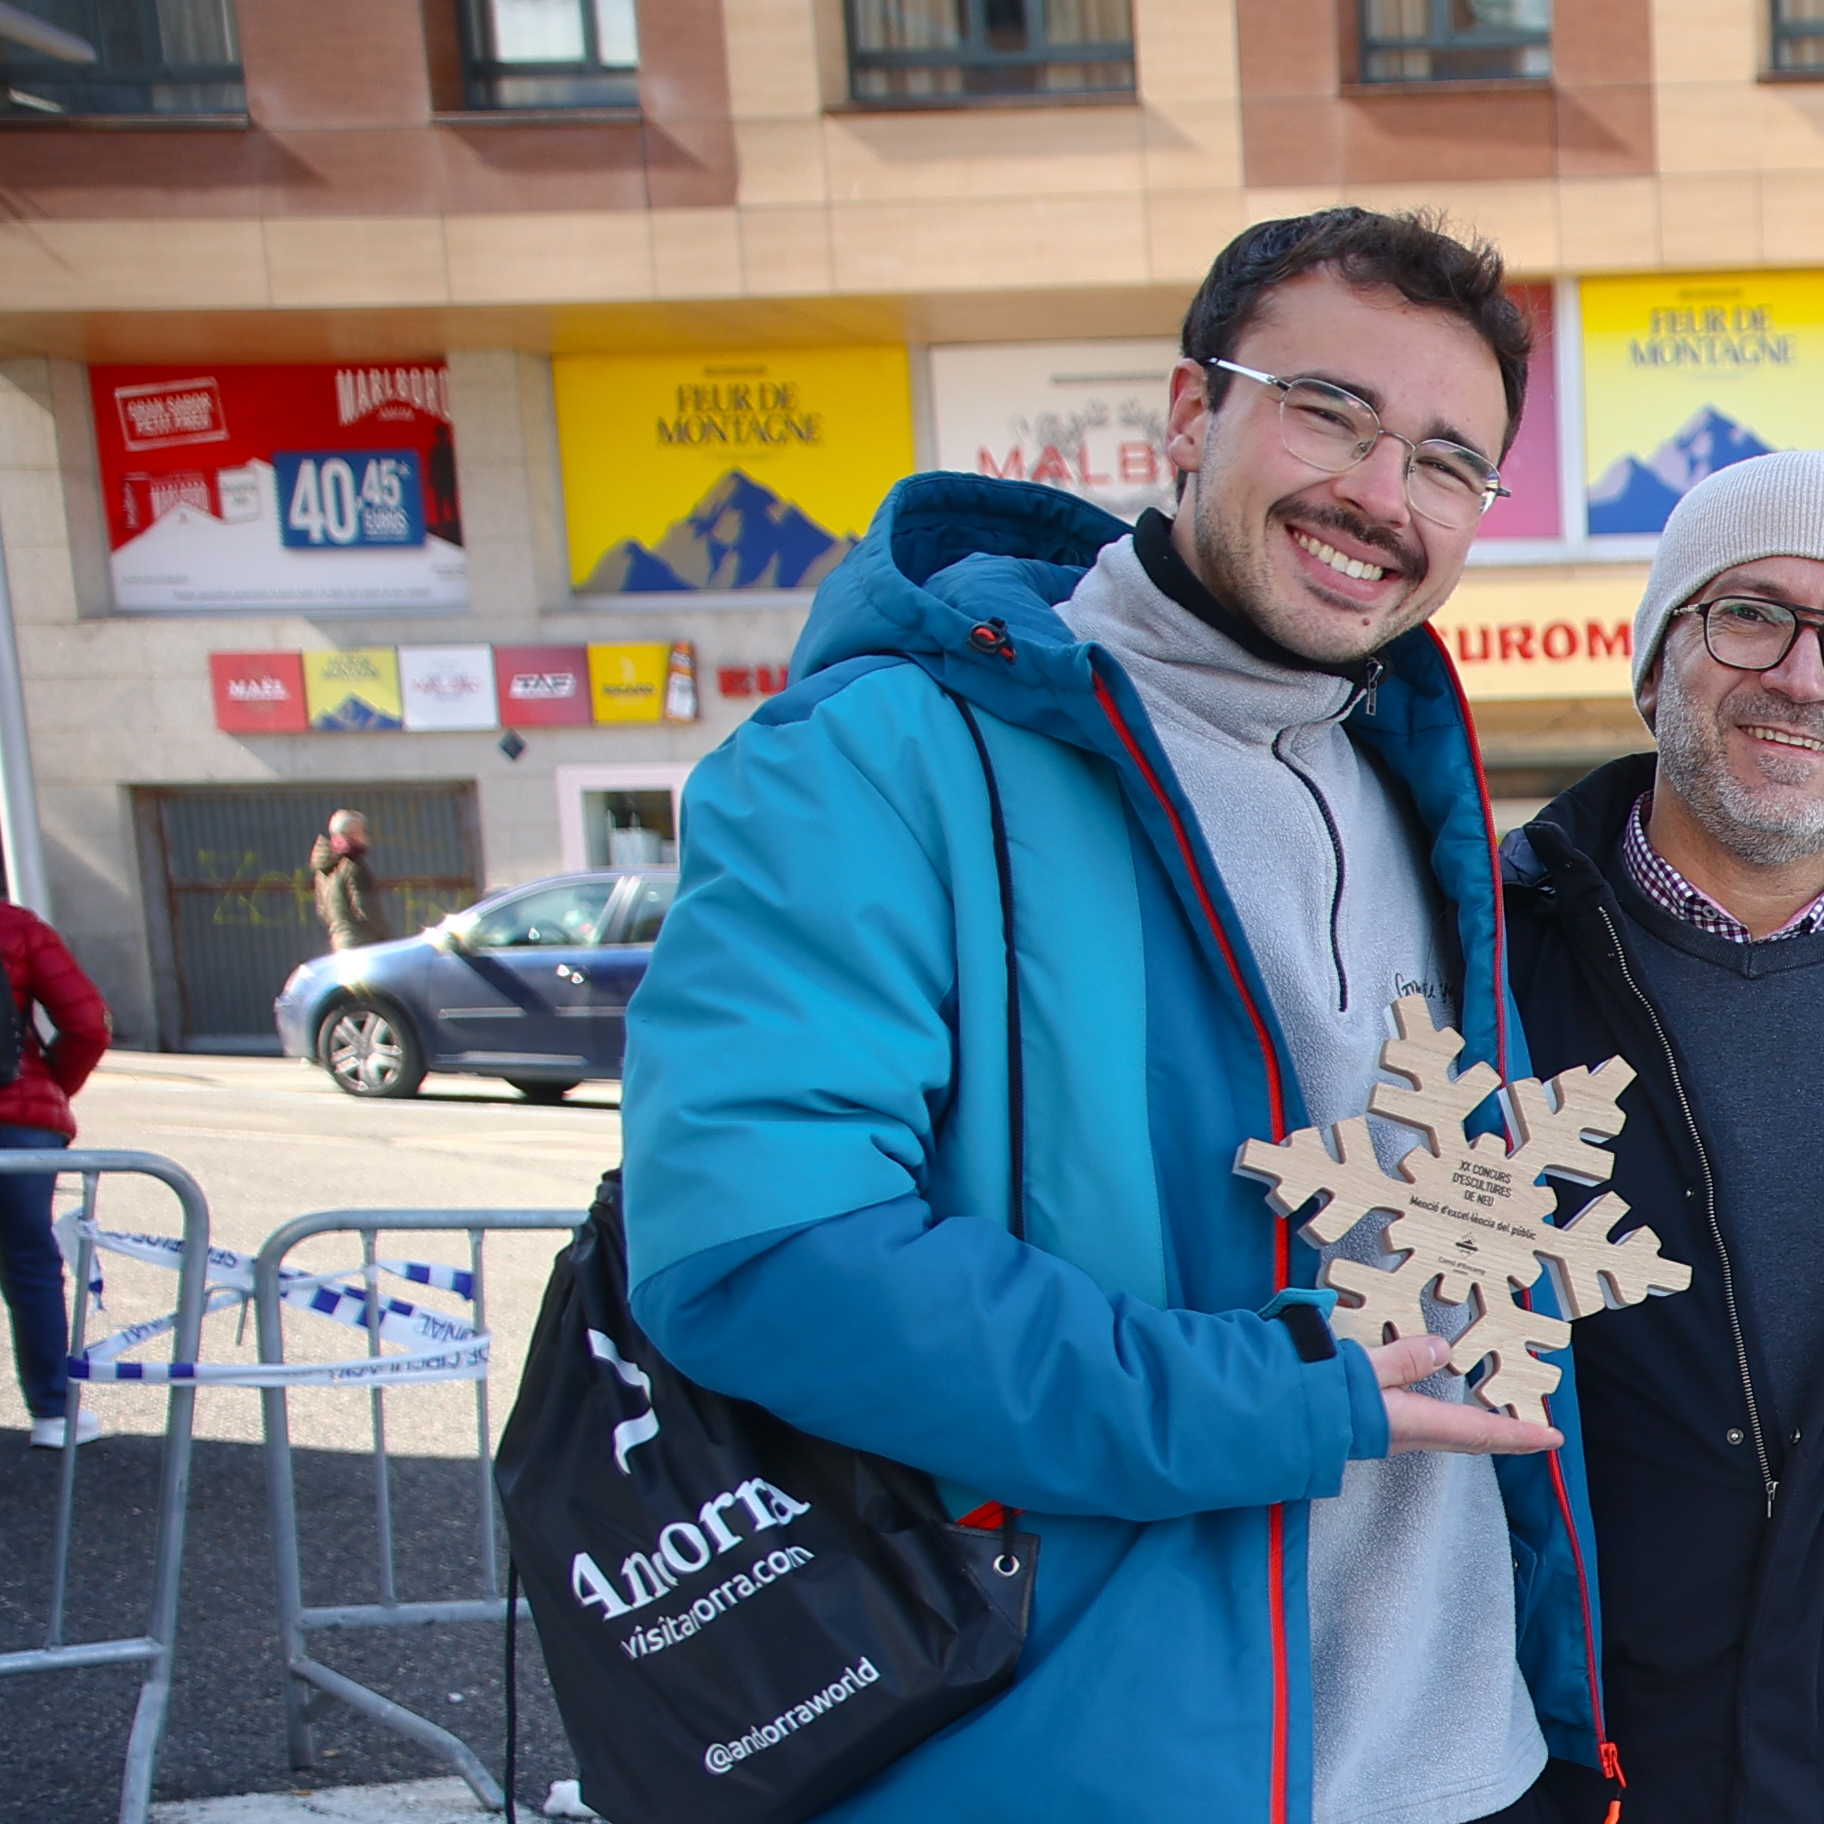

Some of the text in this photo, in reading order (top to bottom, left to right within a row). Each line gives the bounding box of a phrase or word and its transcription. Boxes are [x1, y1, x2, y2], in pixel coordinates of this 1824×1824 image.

[1629, 334, 1796, 366] MONTAGNE
[657, 413, 823, 444] MONTAGNE
[978, 442, 1178, 488] MALB
[1457, 623, 1633, 662] UROM
[716, 665, 788, 697] EU
[1452, 1172, 1513, 1199] D'ESCULTURES
[1459, 1160, 1513, 1184] XX CONCURS
[1464, 1189, 1495, 1208] DE NEU
[1410, 1195, 1440, 1213] Menció
[1497, 1220, 1511, 1232] del
[1511, 1226, 1538, 1241] públic
[705, 1655, 882, 1775] @andorraworld
